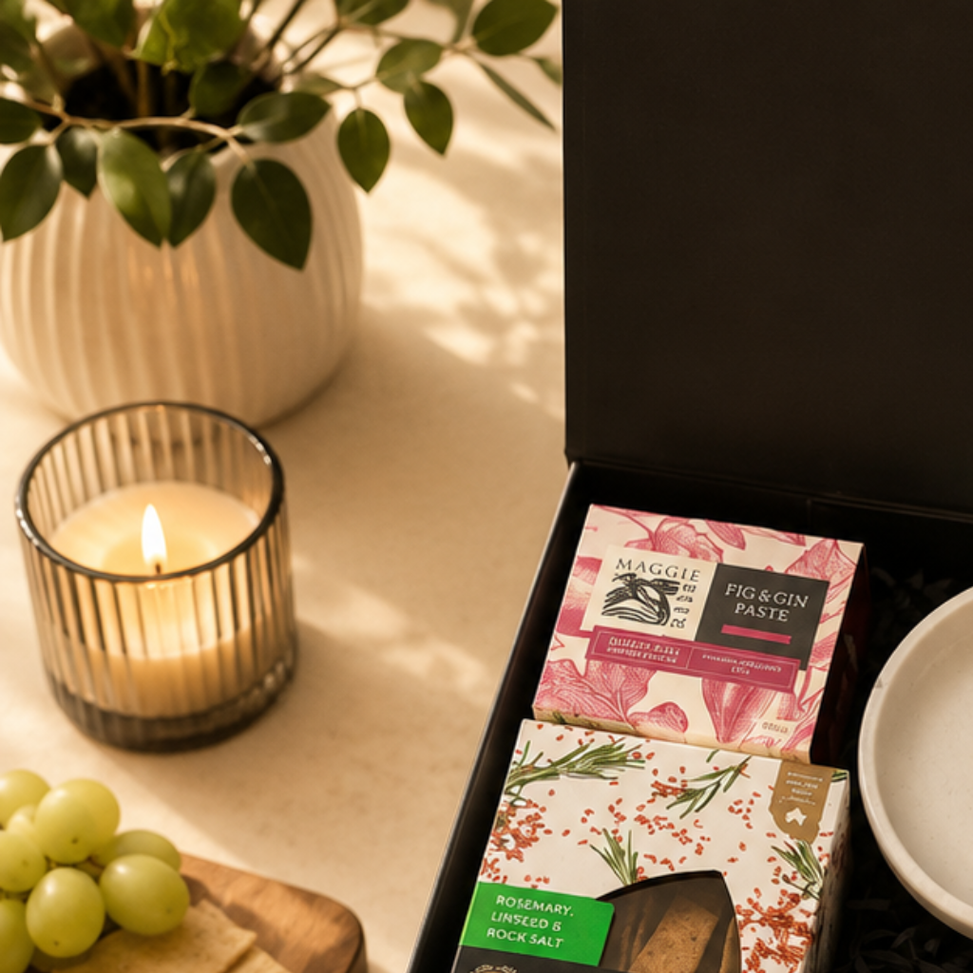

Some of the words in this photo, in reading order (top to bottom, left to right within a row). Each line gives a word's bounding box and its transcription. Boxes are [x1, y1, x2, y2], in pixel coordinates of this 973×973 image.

[615, 557, 701, 582] MAGGIE
[725, 583, 756, 600] FIG
[758, 589, 771, 603] &
[773, 591, 809, 608] GIN
[734, 602, 790, 622] PASTE
[491, 911, 549, 929] LINSEED
[486, 927, 528, 943] ROCK
[529, 933, 565, 948] SALT
